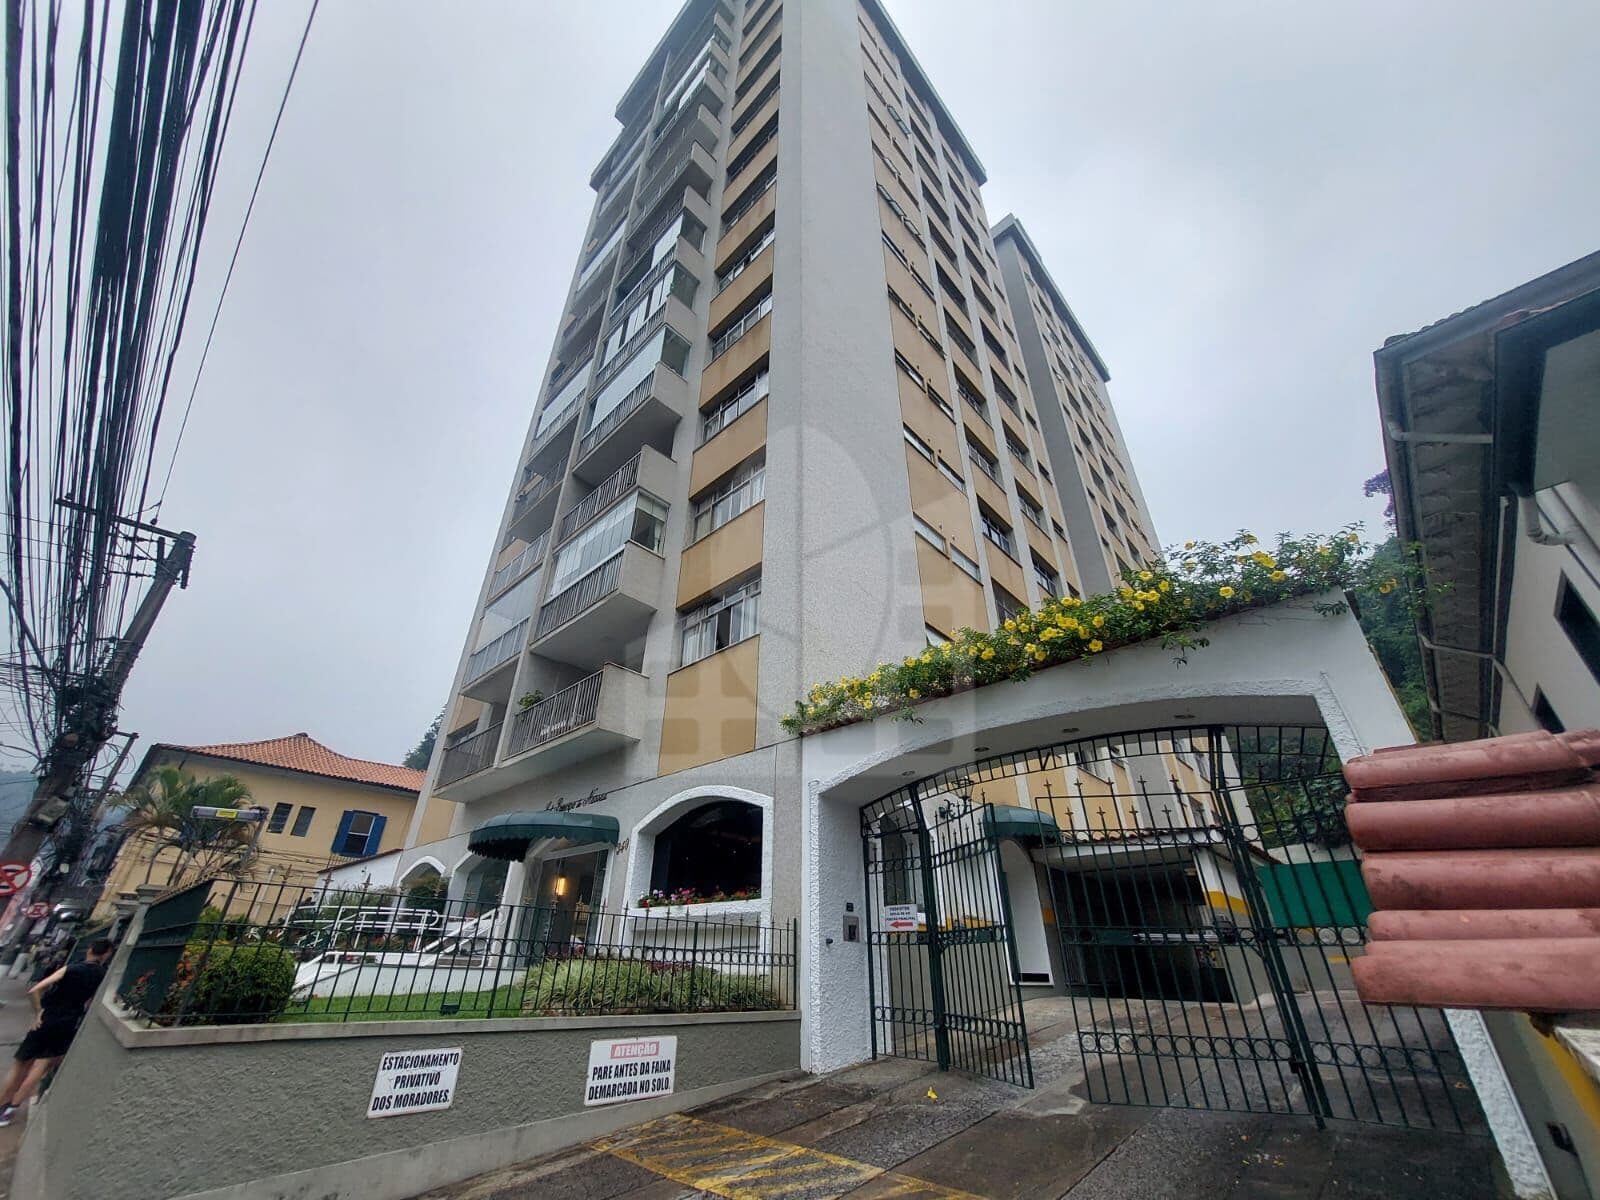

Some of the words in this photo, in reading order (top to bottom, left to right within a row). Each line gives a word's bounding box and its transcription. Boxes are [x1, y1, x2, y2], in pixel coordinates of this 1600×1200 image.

[613, 1041, 657, 1057] ATENÇÃO
[382, 1052, 460, 1071] ESTACIONAMENTO
[592, 1065, 613, 1081] PARE
[614, 1062, 638, 1078] ANTES
[639, 1061, 650, 1075] DA
[651, 1059, 671, 1074] FAIXA
[393, 1071, 441, 1090] PRIVATIVO
[588, 1080, 638, 1101] DEMARCADA
[639, 1079, 650, 1094] NO
[651, 1076, 671, 1092] SOLO.
[371, 1094, 393, 1111] DOS
[393, 1089, 450, 1109] MORADORES.
